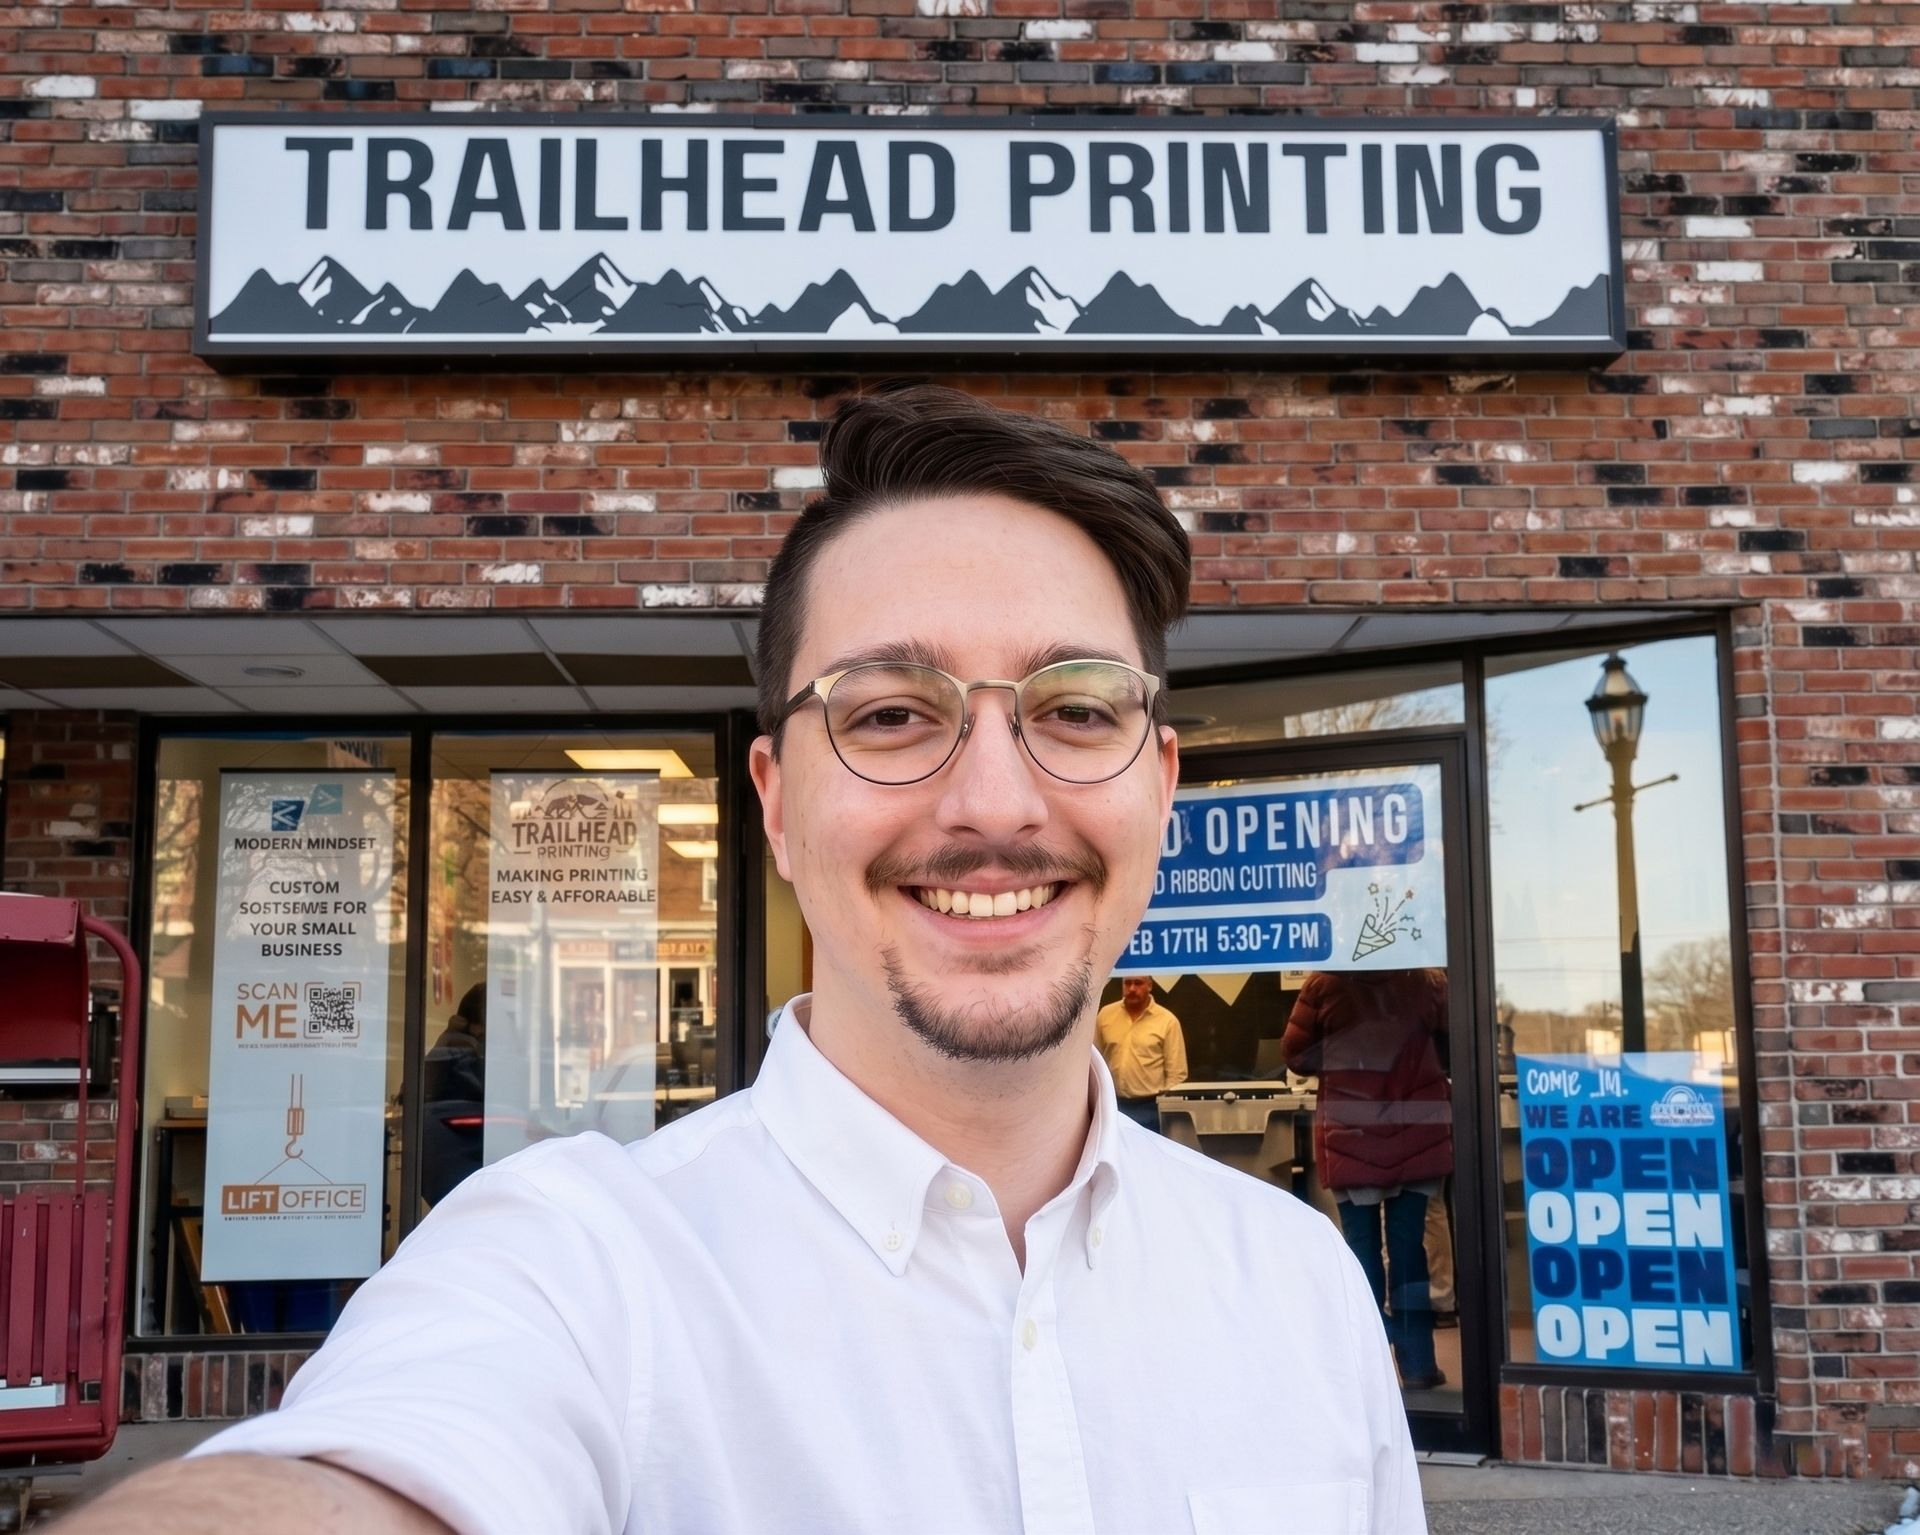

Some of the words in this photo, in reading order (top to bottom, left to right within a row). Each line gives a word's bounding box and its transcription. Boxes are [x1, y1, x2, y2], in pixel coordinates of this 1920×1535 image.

[285, 136, 956, 232] TRAILHEAD
[1009, 140, 1542, 235] PRINTING
[511, 821, 637, 848] TRAILHEAD
[1206, 794, 1408, 857] OPENING
[234, 837, 303, 851] MODERN
[306, 837, 377, 851] MINDSET
[537, 844, 611, 862] PRINTING
[269, 881, 340, 894] CUSTOM
[496, 869, 564, 883] MAKING
[569, 868, 649, 882] PRINTING
[1170, 866, 1236, 895] RIBBON
[1239, 861, 1318, 892] CUTTING
[333, 901, 367, 915] FOR
[491, 890, 533, 904] EASY
[537, 890, 547, 903] &
[250, 922, 297, 936] YOUR
[302, 922, 357, 936] SMALL
[1121, 929, 1154, 956] EB
[1160, 926, 1208, 955] 17TH
[1217, 923, 1283, 952] 5:30-7
[1288, 921, 1319, 949] PM
[261, 942, 343, 957] BUSINESS
[236, 982, 298, 1001] SCAN
[236, 1003, 298, 1040] ME
[1523, 1103, 1570, 1129] WE
[1576, 1103, 1643, 1129] ARE
[1525, 1137, 1720, 1190] OPEN
[227, 1190, 276, 1210] LIFT
[282, 1189, 362, 1208] OFFICE
[1528, 1191, 1724, 1248] OPEN
[1532, 1246, 1729, 1305] OPEN
[1536, 1304, 1734, 1367] OPEN
